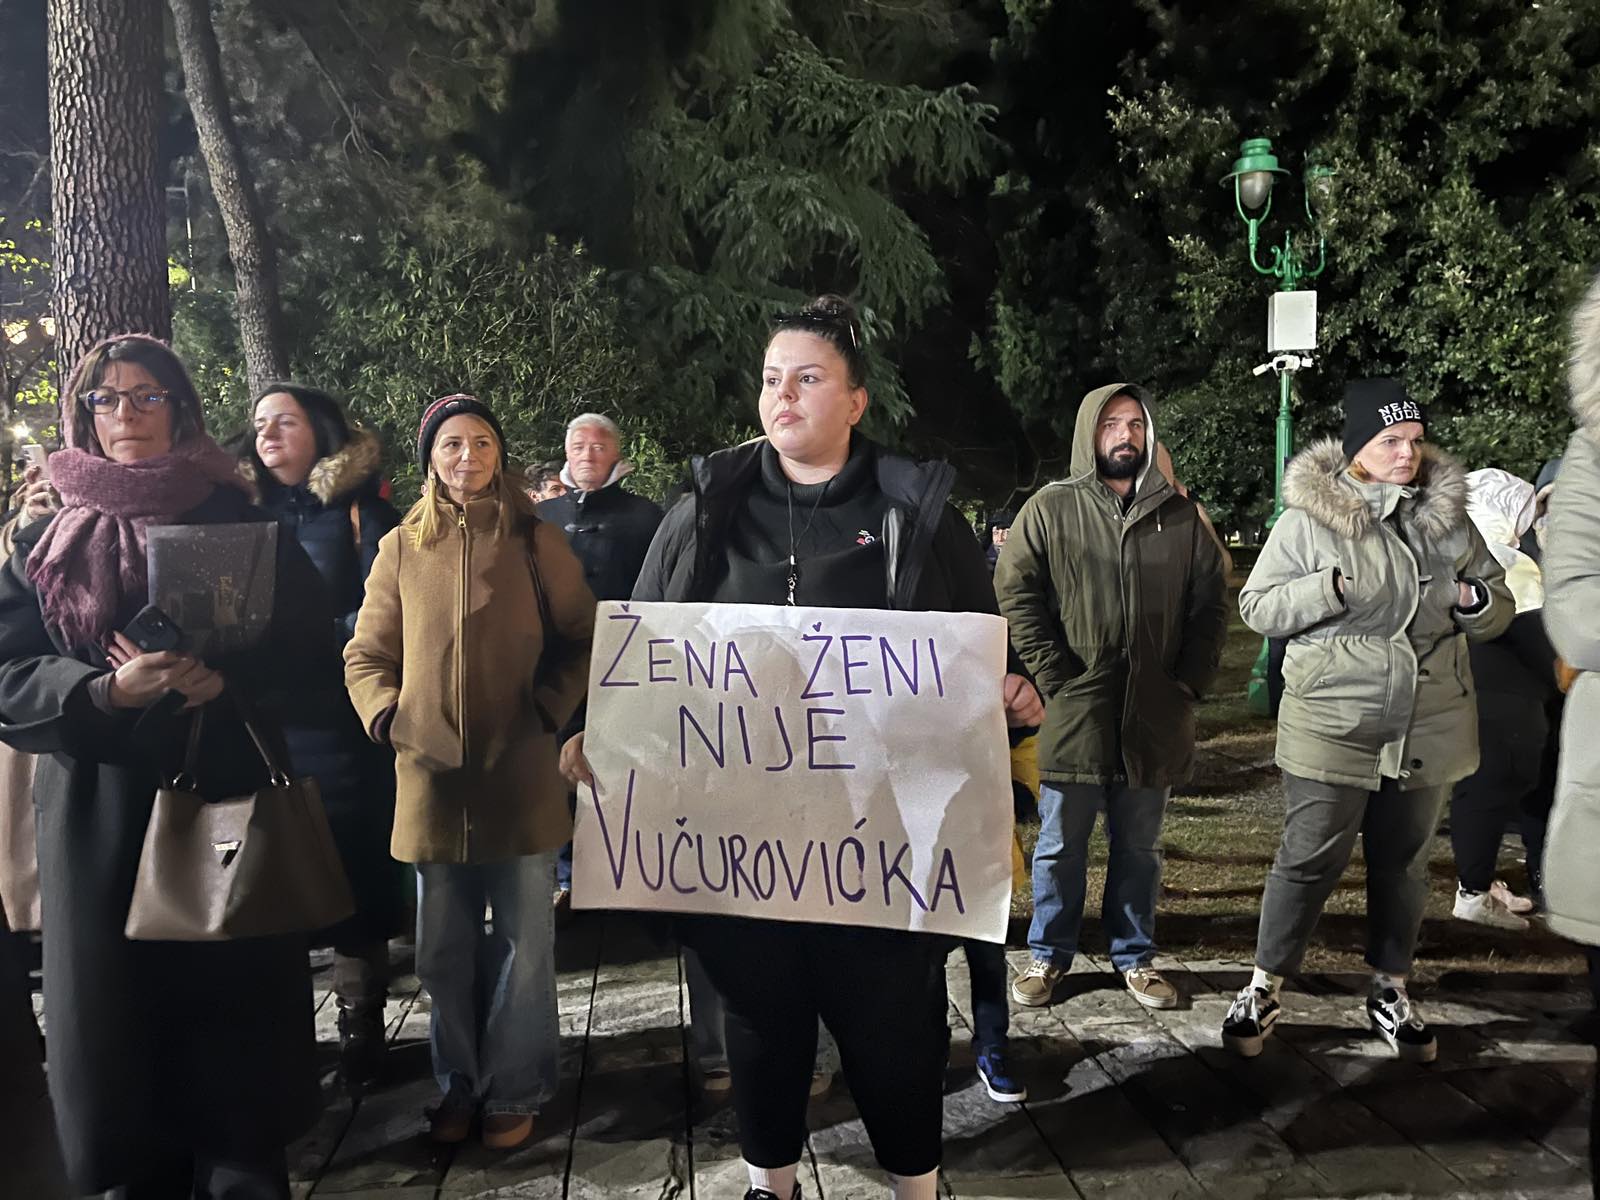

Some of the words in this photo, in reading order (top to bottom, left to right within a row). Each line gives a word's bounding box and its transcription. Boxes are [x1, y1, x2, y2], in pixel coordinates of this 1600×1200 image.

[1383, 410, 1421, 426] DUDE
[600, 603, 758, 698] ŽENA
[800, 621, 945, 699] ŽENI
[678, 701, 856, 772] NIJE
[589, 768, 965, 914] VUČUROVIĆKA
